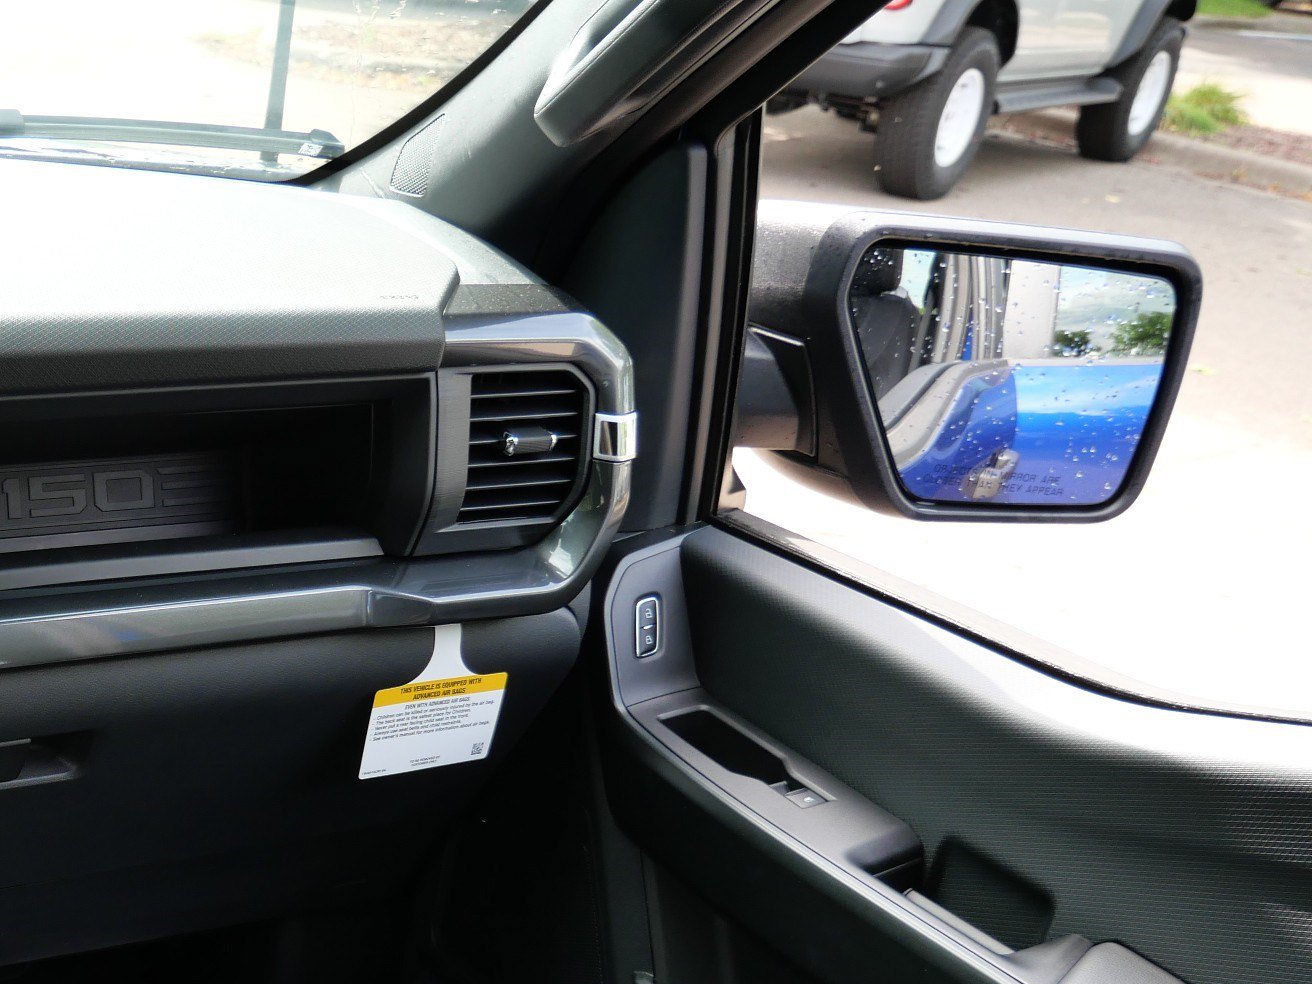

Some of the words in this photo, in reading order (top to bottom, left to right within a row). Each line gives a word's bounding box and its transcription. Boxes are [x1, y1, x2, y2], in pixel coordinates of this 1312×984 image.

[1025, 485, 1064, 496] APPEAR
[442, 679, 467, 687] EQUIPPED
[413, 691, 440, 699] ADVANCED
